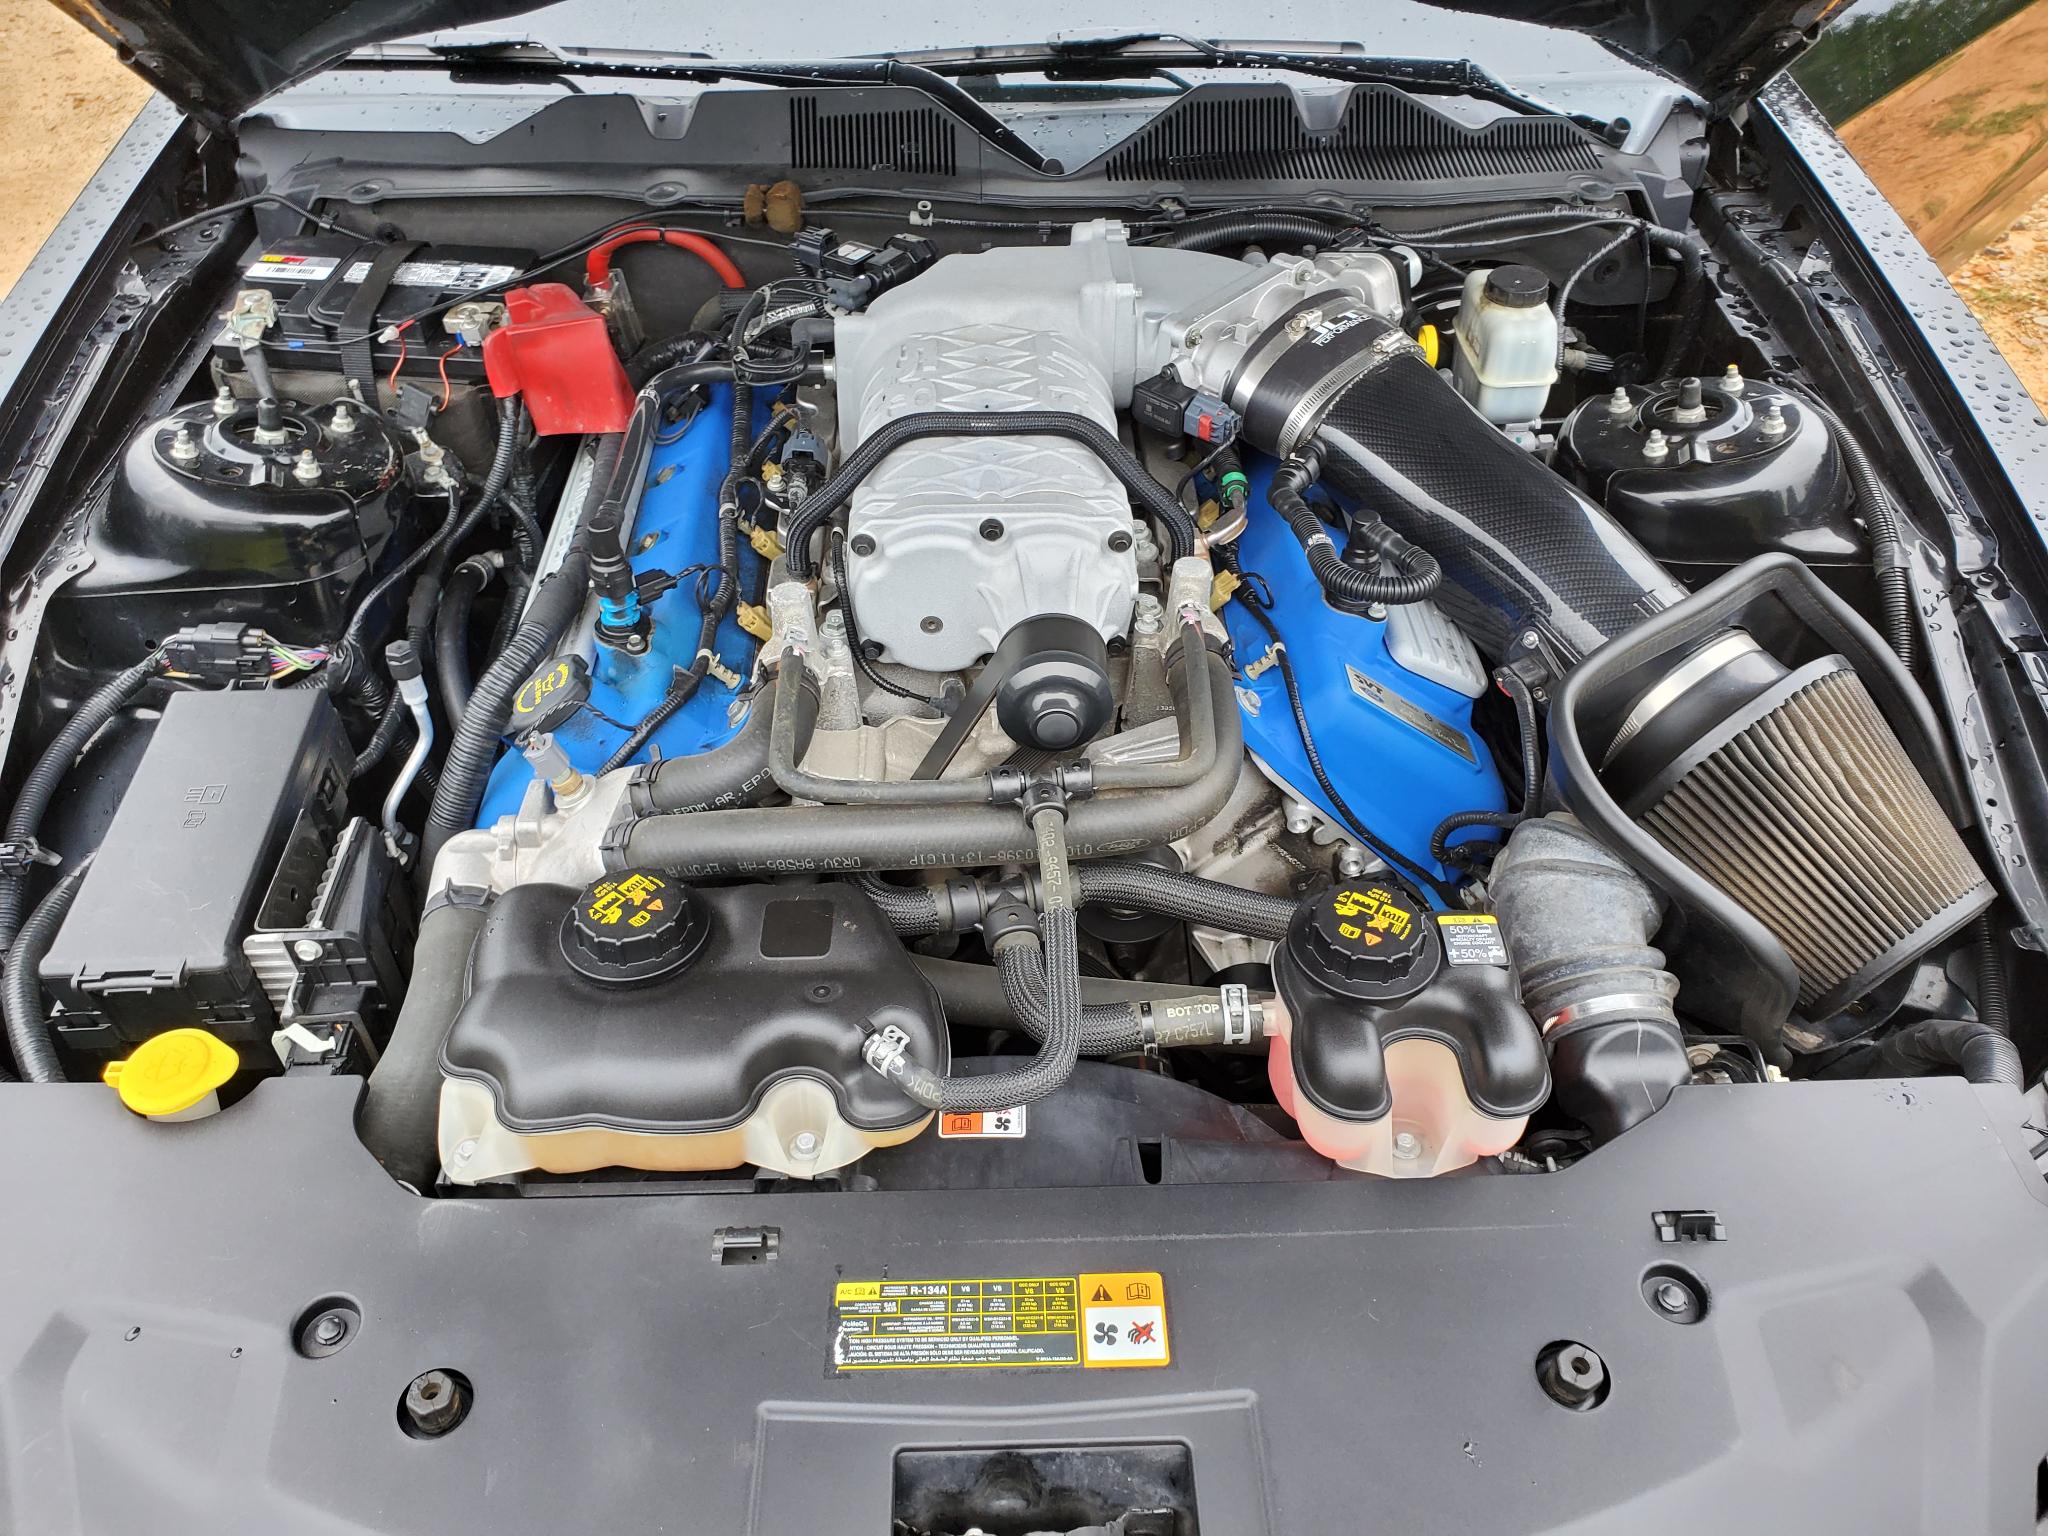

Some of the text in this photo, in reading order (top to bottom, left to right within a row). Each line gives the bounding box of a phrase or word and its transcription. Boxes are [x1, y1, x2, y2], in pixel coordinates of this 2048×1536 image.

[1449, 925, 1476, 934] 50%
[1166, 1003, 1220, 1018] BOT TOP
[910, 1285, 948, 1295] R-134A
